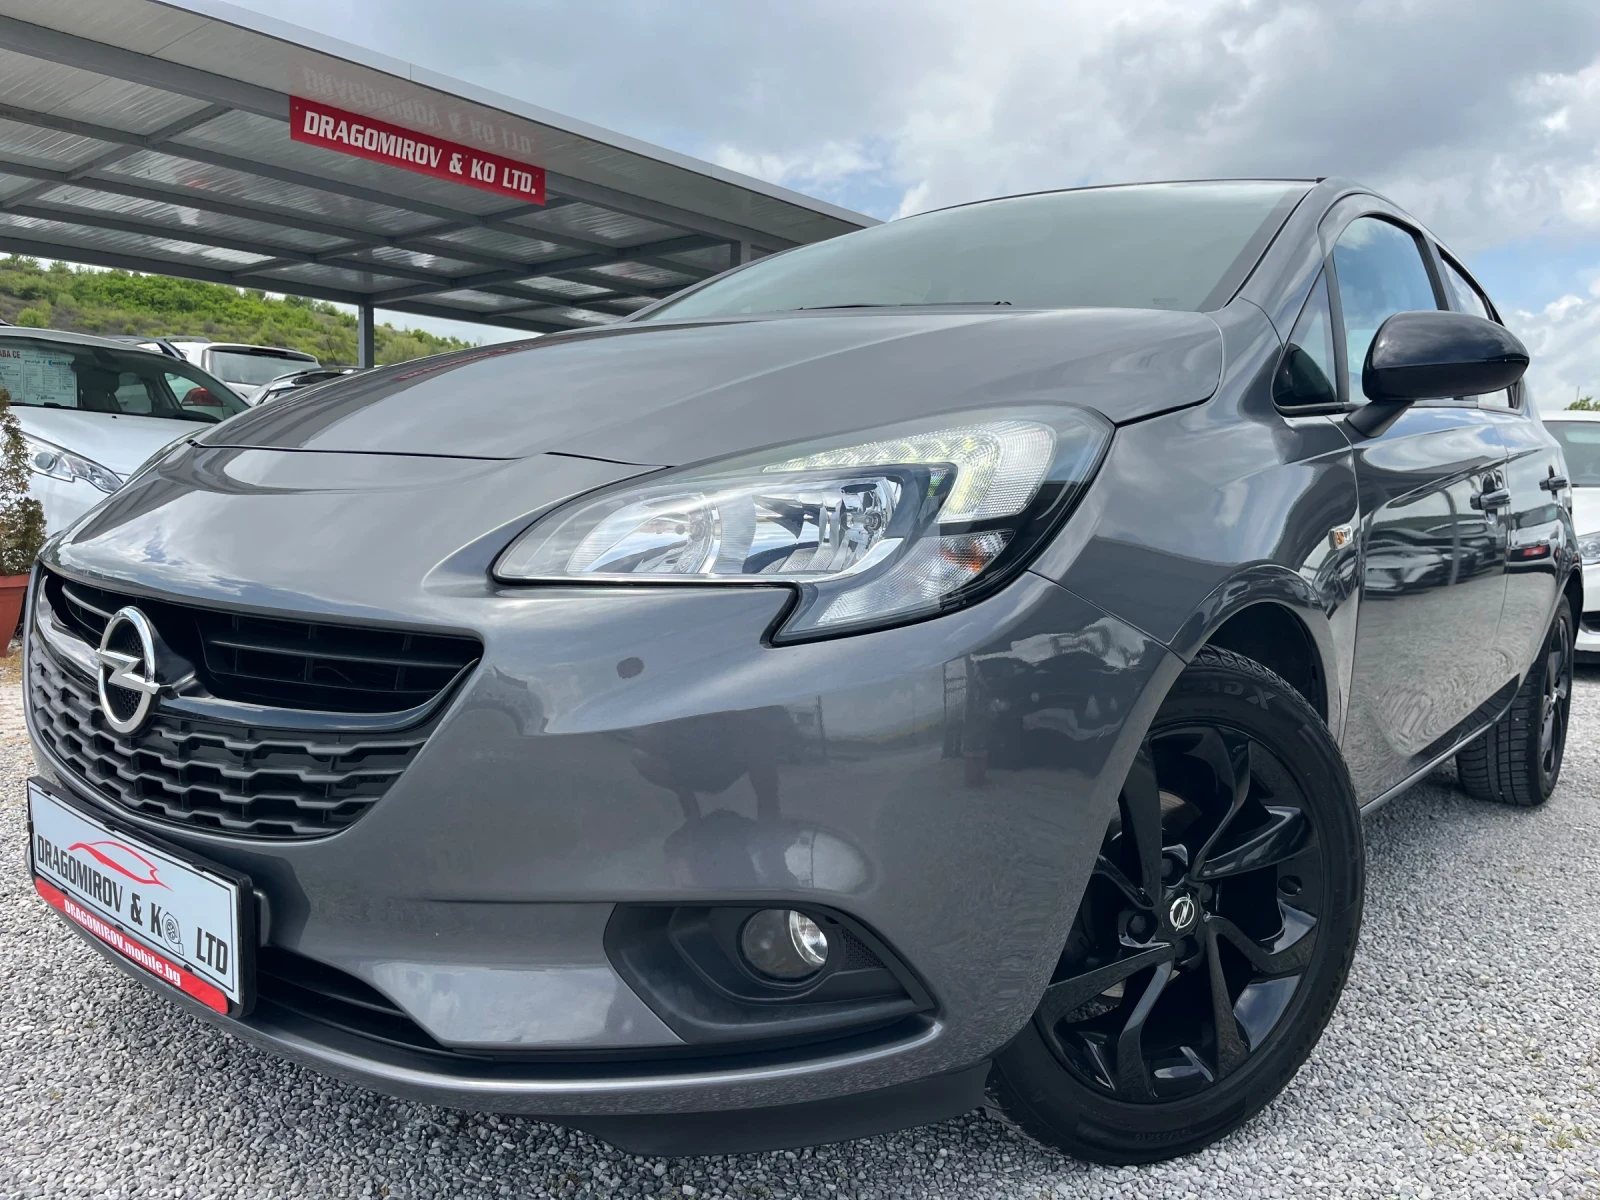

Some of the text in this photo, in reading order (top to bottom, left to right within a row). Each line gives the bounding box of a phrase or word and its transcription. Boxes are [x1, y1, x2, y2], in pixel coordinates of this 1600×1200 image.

[303, 110, 536, 194] DRAGOMIROV & KO LTD.
[37, 834, 123, 913] DRAGOMIROV
[130, 892, 143, 926] &
[196, 927, 228, 976] LTD
[64, 898, 181, 987] DRAGOMIROV.mobile.bg
